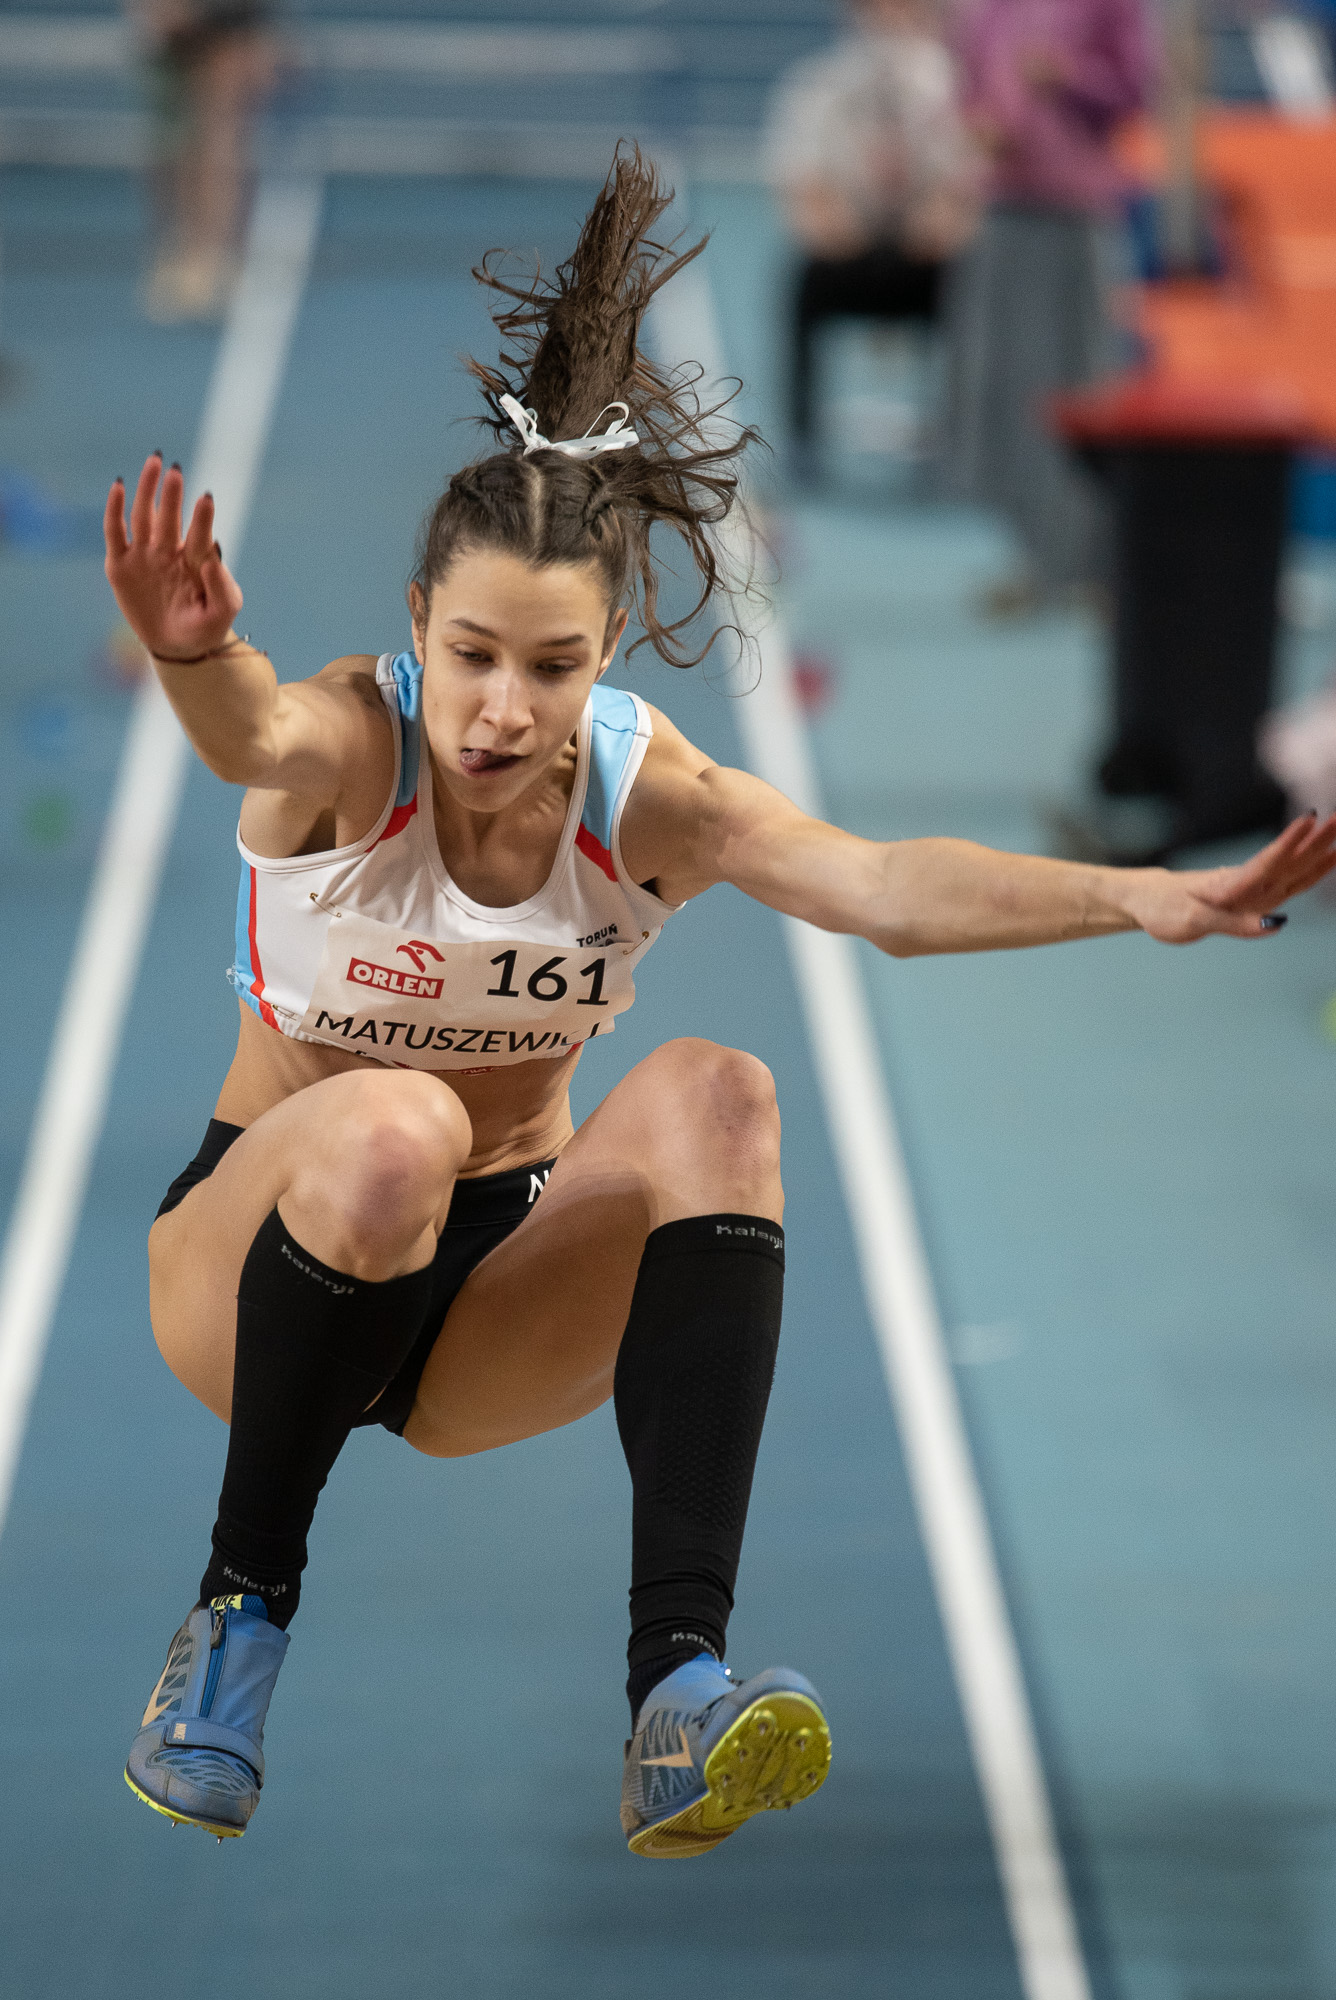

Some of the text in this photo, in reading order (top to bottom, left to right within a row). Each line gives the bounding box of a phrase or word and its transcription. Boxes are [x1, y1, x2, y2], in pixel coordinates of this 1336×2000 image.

[576, 923, 618, 948] TORUŃ
[353, 963, 438, 997] ORLEN
[487, 949, 609, 1006] 161
